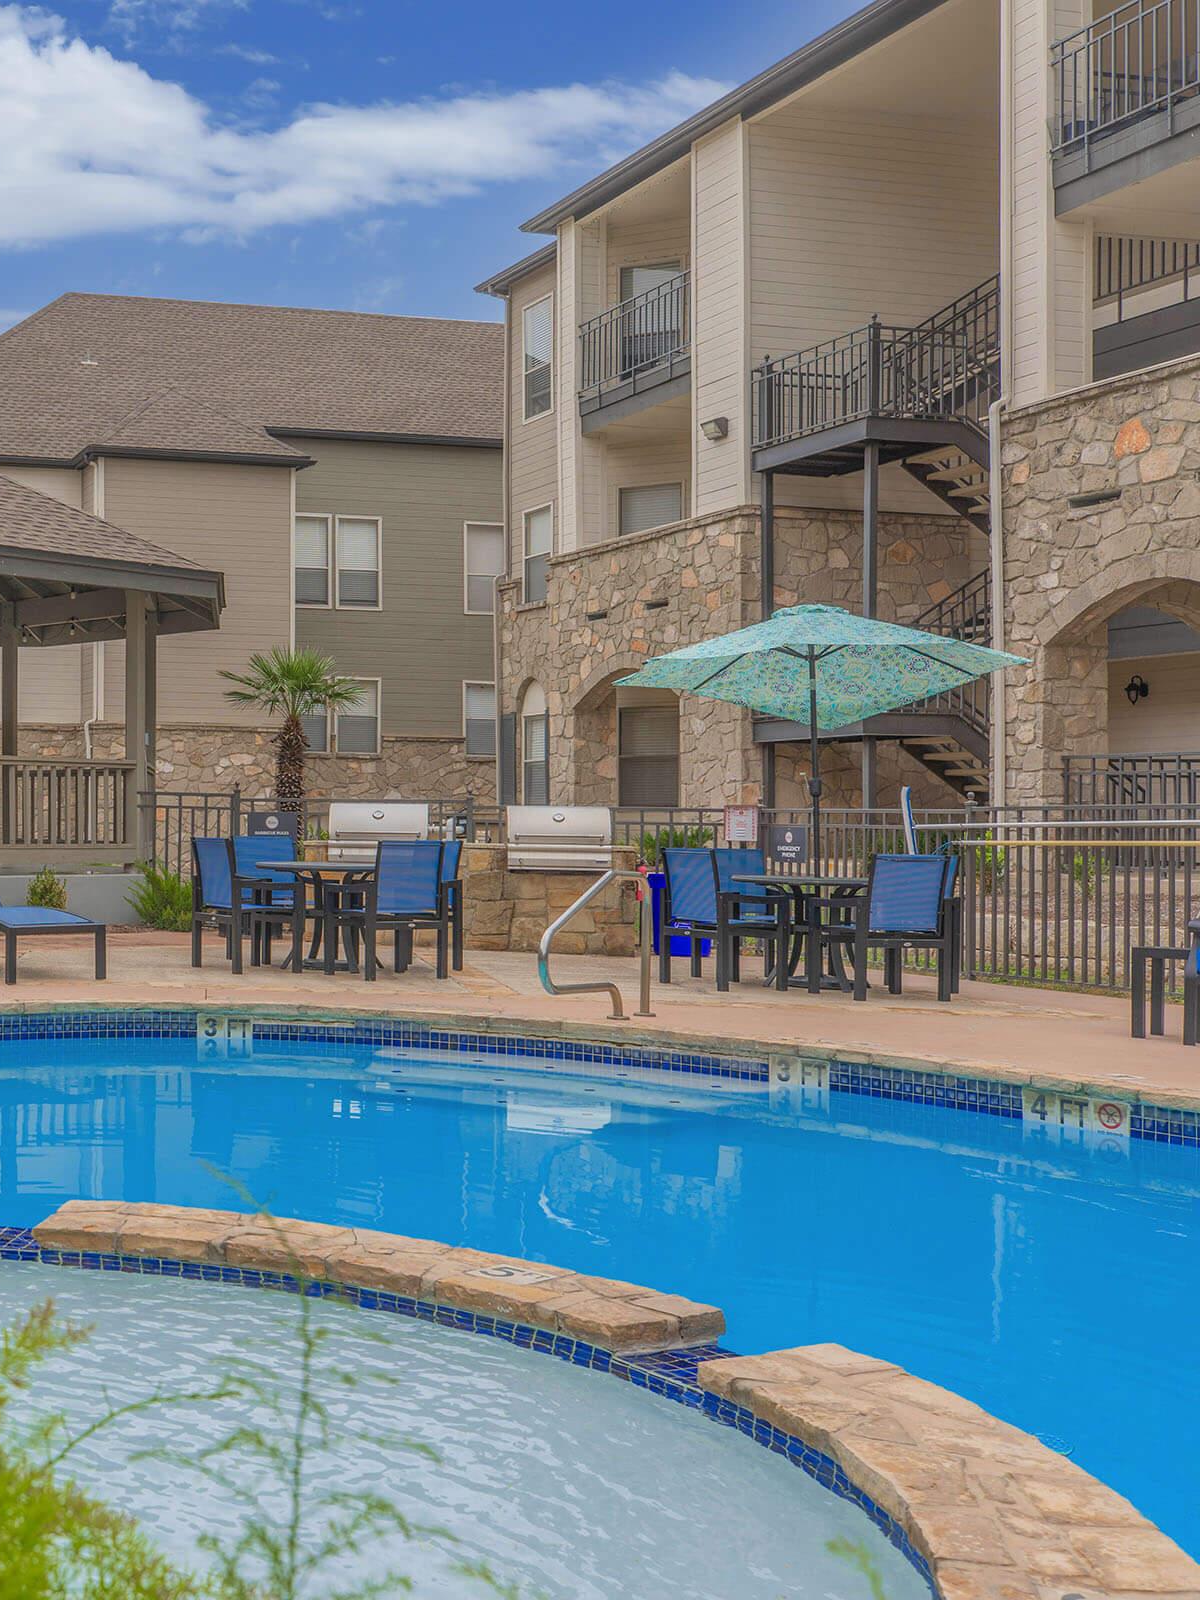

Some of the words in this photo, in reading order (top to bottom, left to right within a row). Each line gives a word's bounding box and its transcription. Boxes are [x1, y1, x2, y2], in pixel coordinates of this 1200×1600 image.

[204, 1018, 218, 1037] 3
[227, 1019, 250, 1038] FT
[776, 1059, 791, 1082] 3
[801, 1062, 827, 1088] FT
[1030, 1094, 1048, 1120] 4
[1060, 1099, 1088, 1128] FT
[479, 1266, 526, 1277] 5
